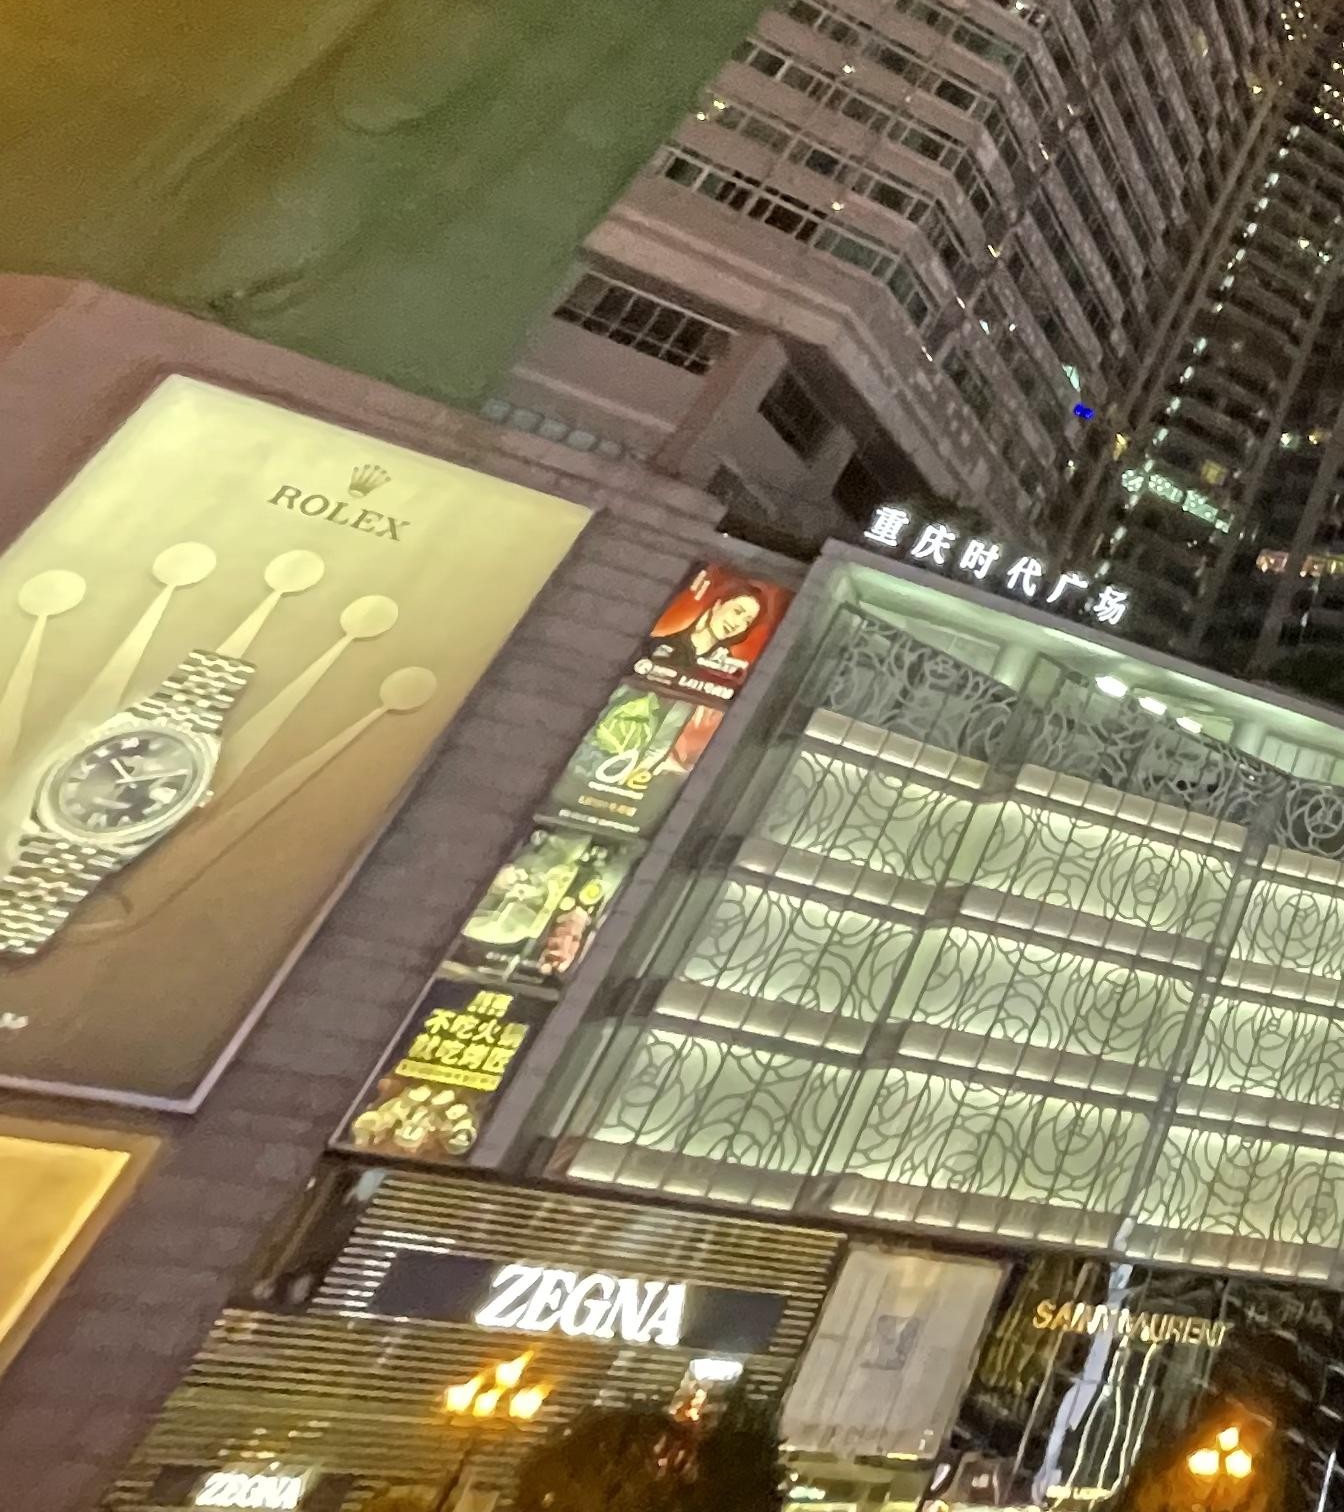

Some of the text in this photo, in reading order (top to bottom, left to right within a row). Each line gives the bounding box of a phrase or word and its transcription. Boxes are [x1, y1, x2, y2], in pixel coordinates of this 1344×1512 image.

[267, 485, 411, 542] ROLEX
[863, 506, 1129, 625] 重庆时代广场
[475, 1263, 687, 1346] ZEGNA
